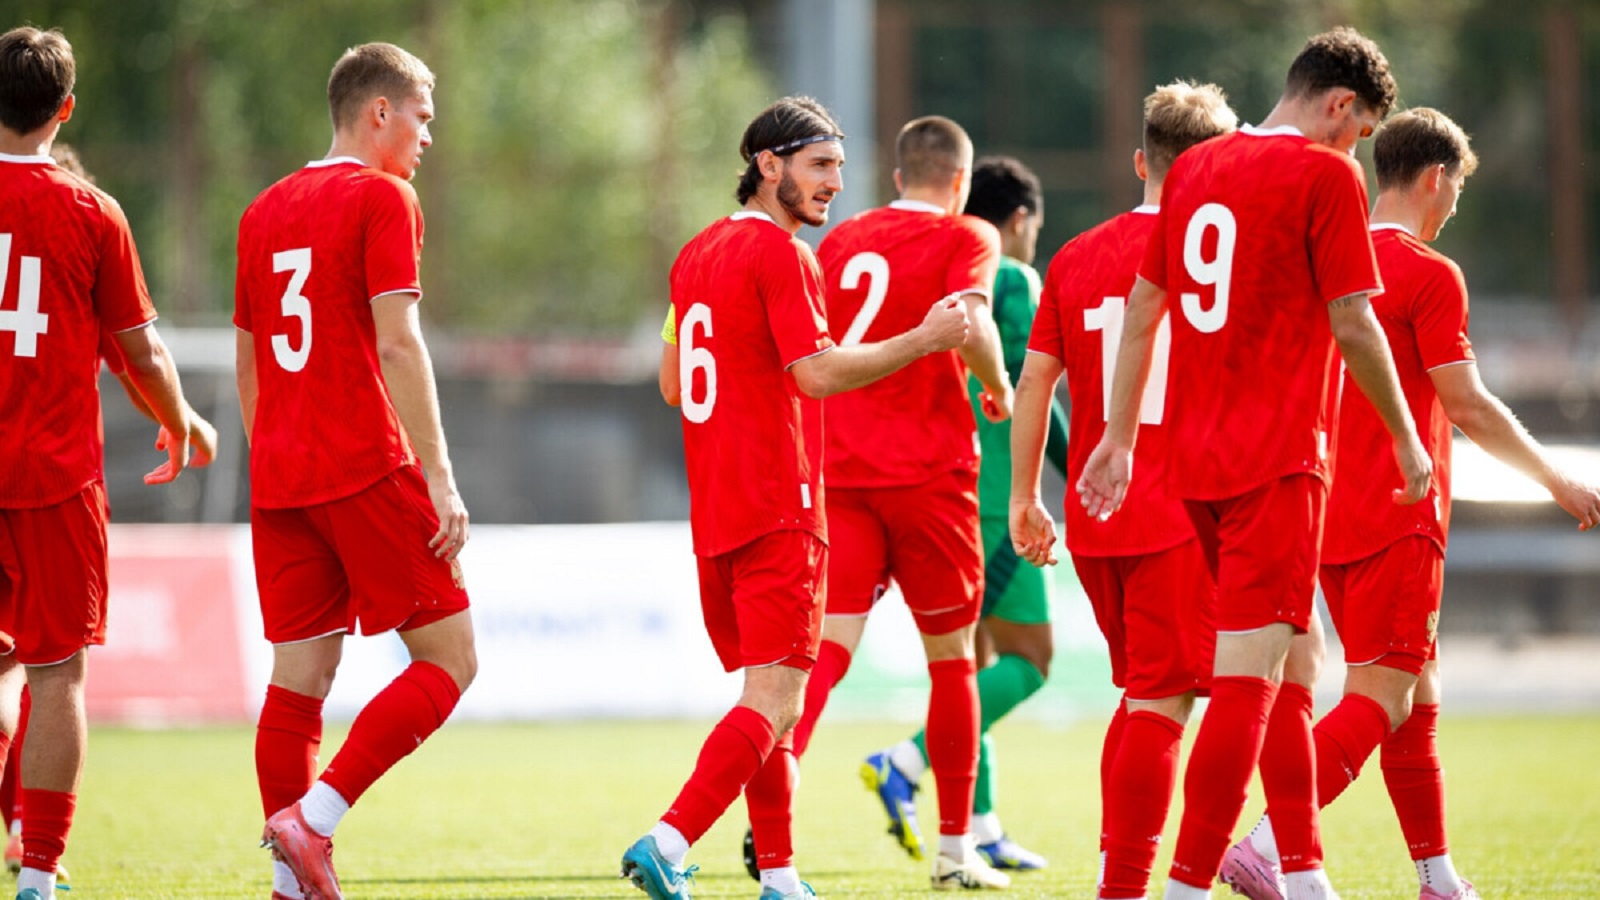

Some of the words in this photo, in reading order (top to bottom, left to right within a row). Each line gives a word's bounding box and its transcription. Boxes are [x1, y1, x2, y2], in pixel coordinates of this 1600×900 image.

[0, 232, 49, 358] 4
[271, 247, 313, 373] 3
[840, 251, 890, 347] 2
[1181, 203, 1237, 333] 9
[679, 302, 717, 424] 6
